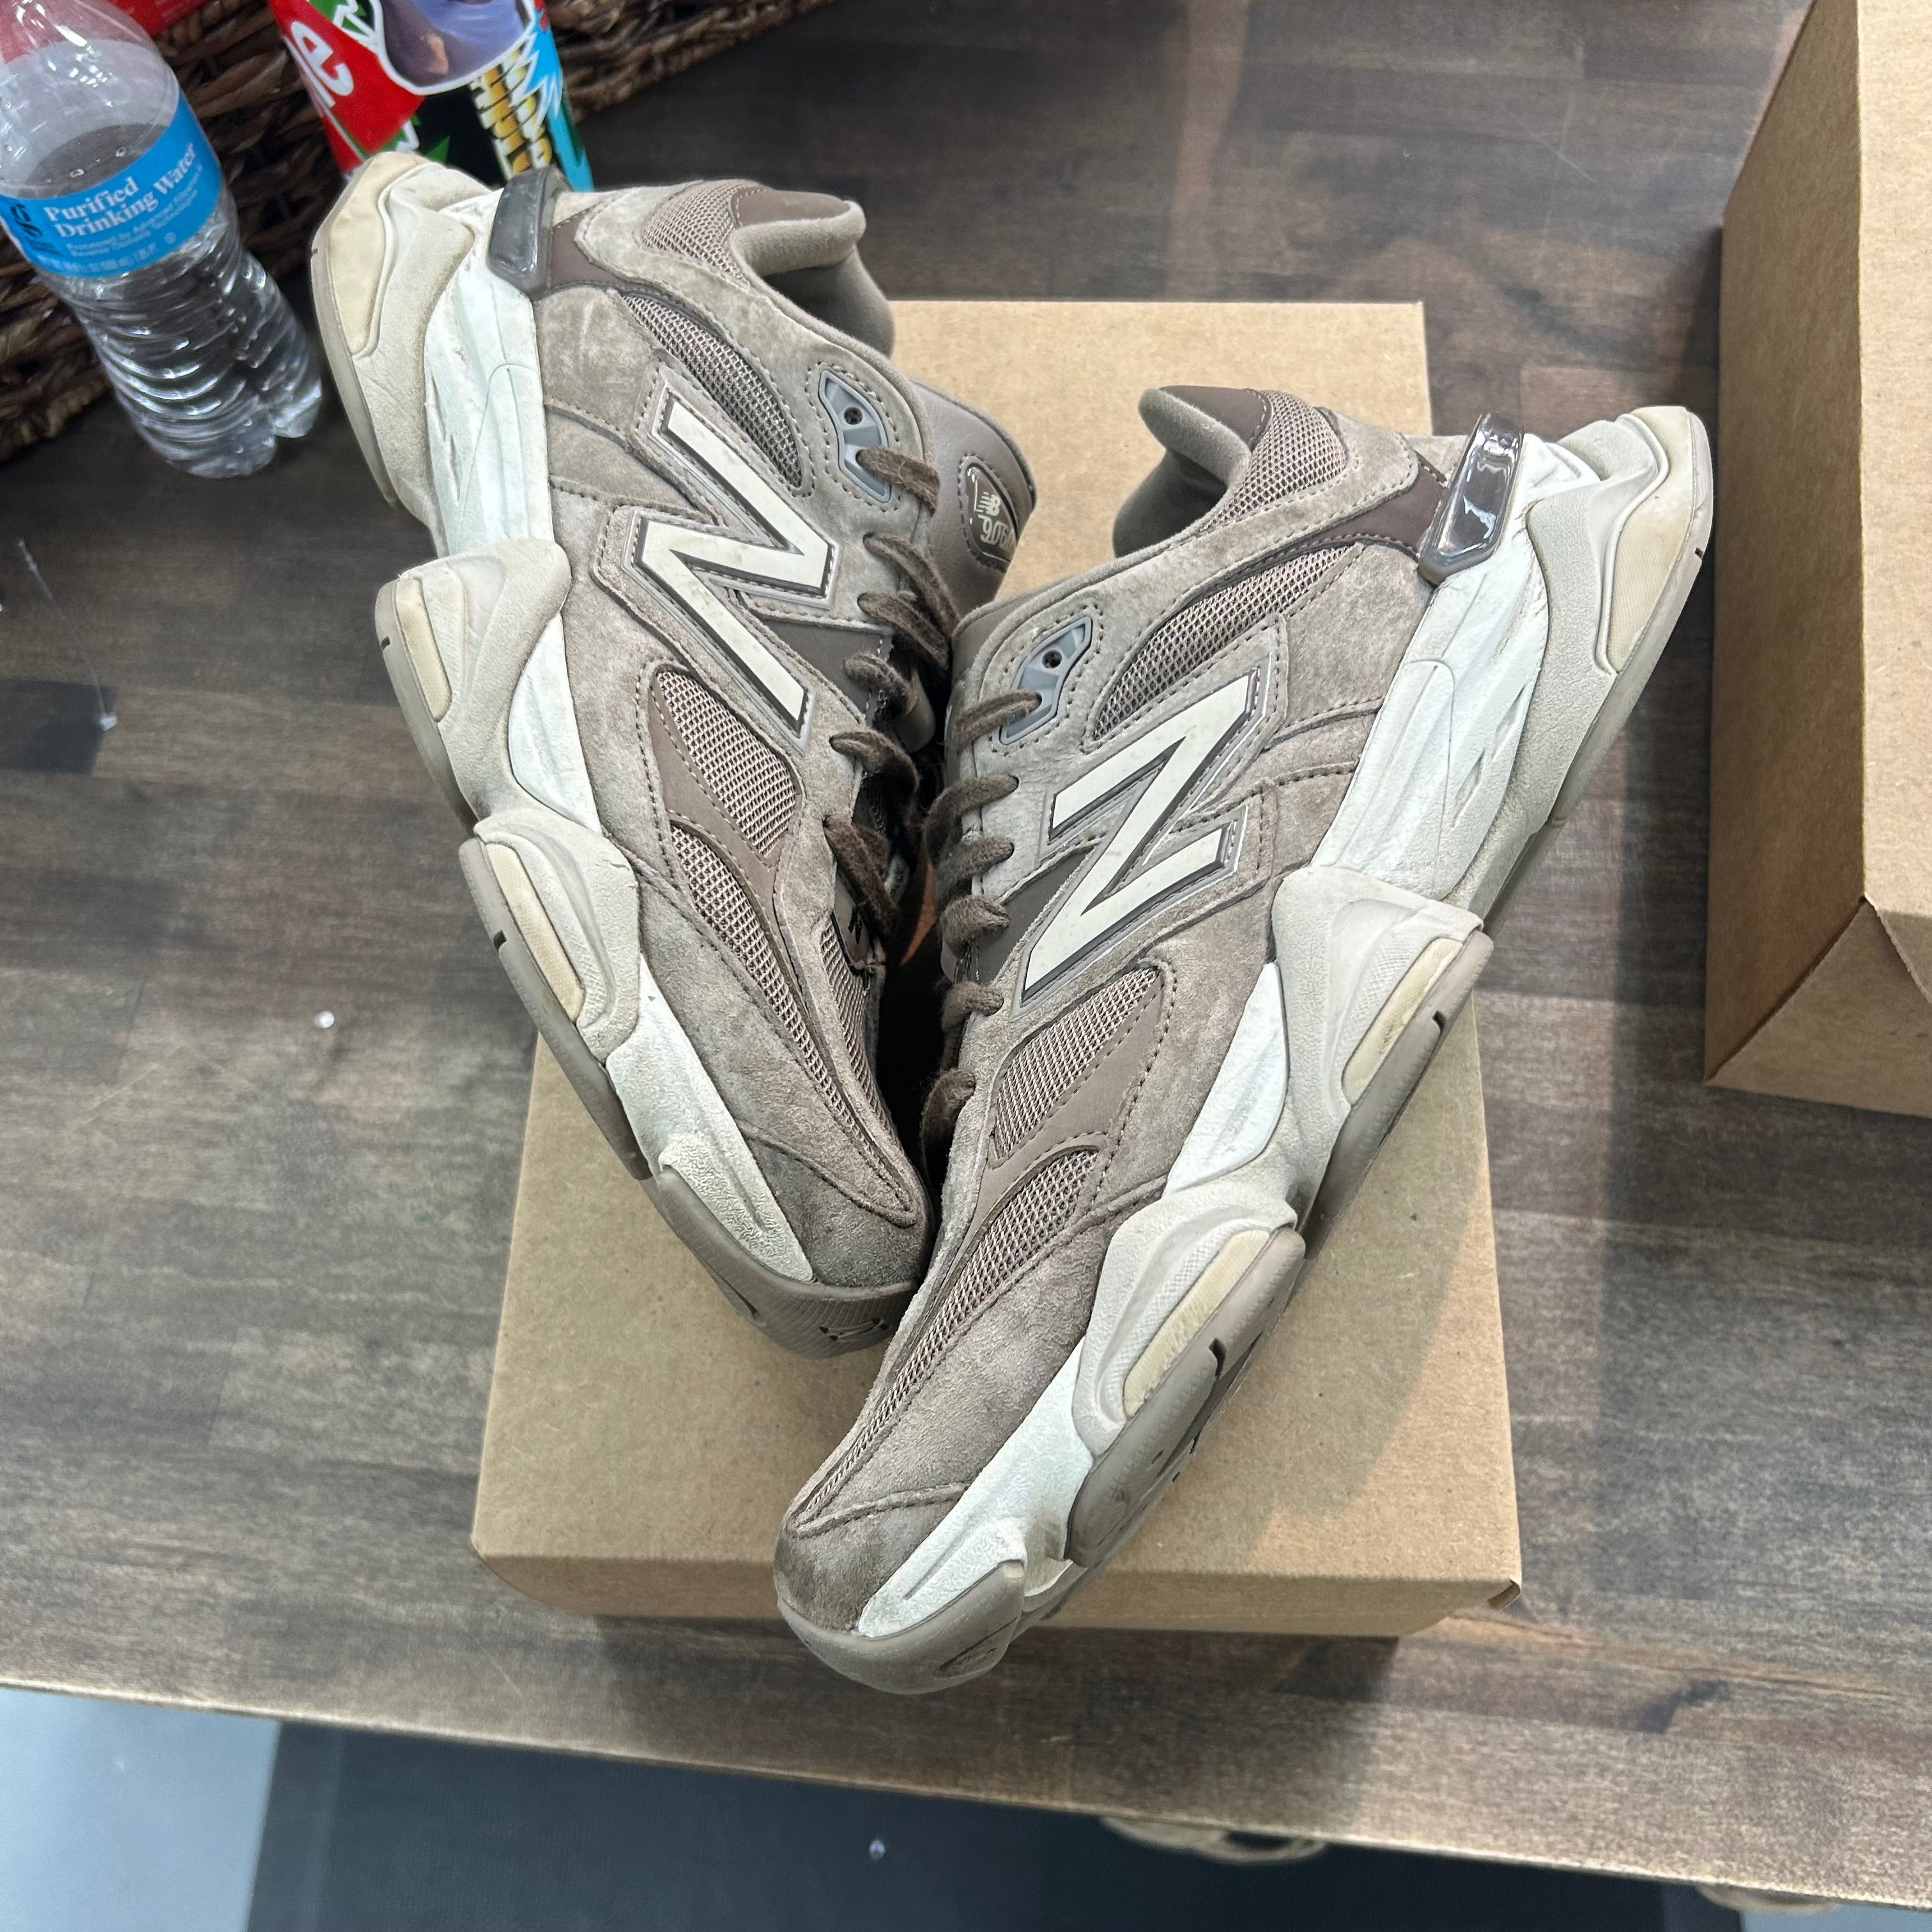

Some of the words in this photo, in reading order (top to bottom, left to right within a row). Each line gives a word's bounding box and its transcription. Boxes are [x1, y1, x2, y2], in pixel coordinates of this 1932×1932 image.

[43, 176, 139, 222] Purified
[54, 192, 158, 237] Drinking
[153, 142, 195, 194] Water
[635, 394, 833, 735] N
[1022, 670, 1255, 1000] N
